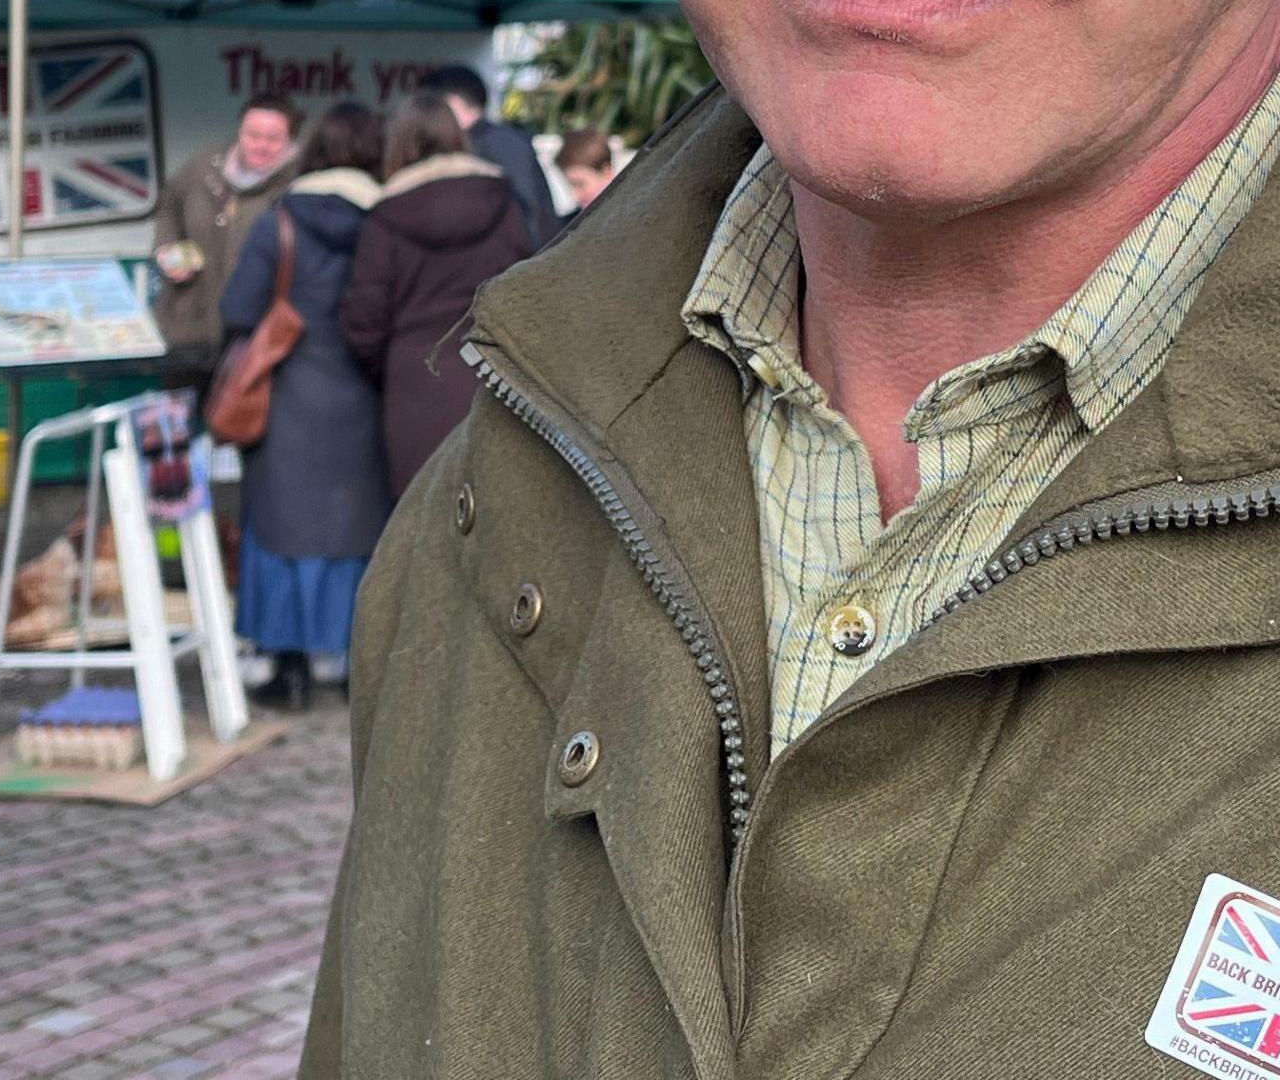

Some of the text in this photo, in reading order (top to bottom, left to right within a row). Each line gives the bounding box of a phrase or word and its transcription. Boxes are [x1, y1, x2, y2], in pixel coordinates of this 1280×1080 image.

[223, 42, 440, 104] Thank yo
[1206, 952, 1251, 984] BACK
[1169, 1035, 1269, 1080] #BACKBRIT
